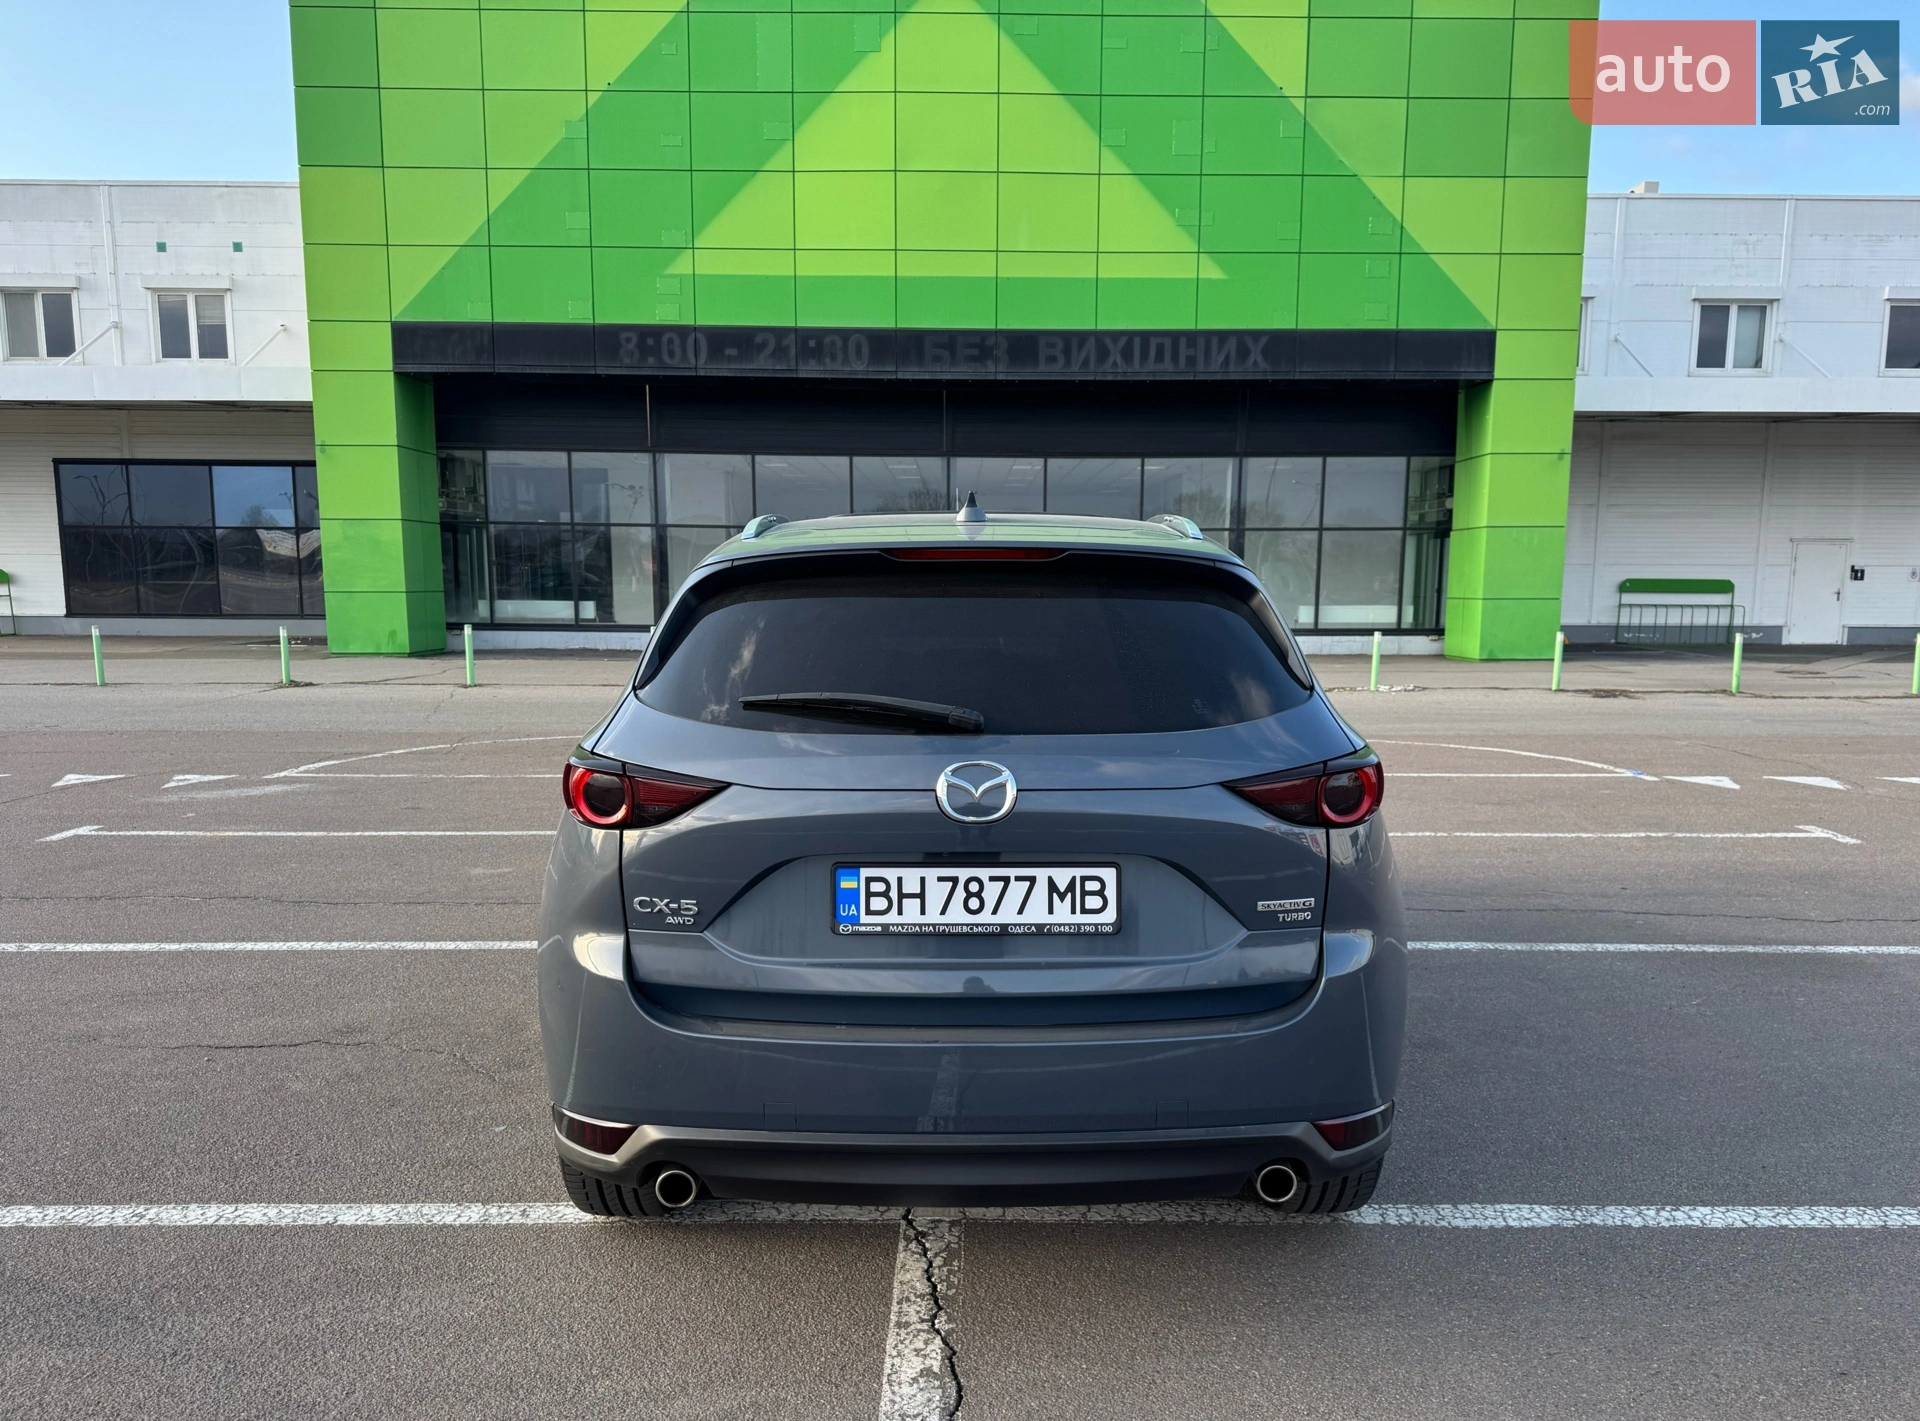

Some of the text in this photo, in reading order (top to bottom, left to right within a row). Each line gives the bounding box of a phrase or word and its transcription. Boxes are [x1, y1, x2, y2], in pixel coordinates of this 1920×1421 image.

[923, 335, 1010, 370] БЕЗ
[1037, 335, 1271, 371] ВИХІДНИХ
[864, 875, 1109, 916] BH 7877 MB
[633, 896, 699, 915] CX-5
[840, 905, 858, 917] UA
[664, 916, 694, 925] AWD
[1277, 911, 1312, 922] TURBO
[853, 924, 882, 933] mazda
[889, 925, 920, 933] MAZDA
[936, 925, 1000, 934] ГРУШЕВСЬКОГО
[1008, 925, 1037, 934] ОДЕСА
[1051, 924, 1113, 934] (0482) 390 100
